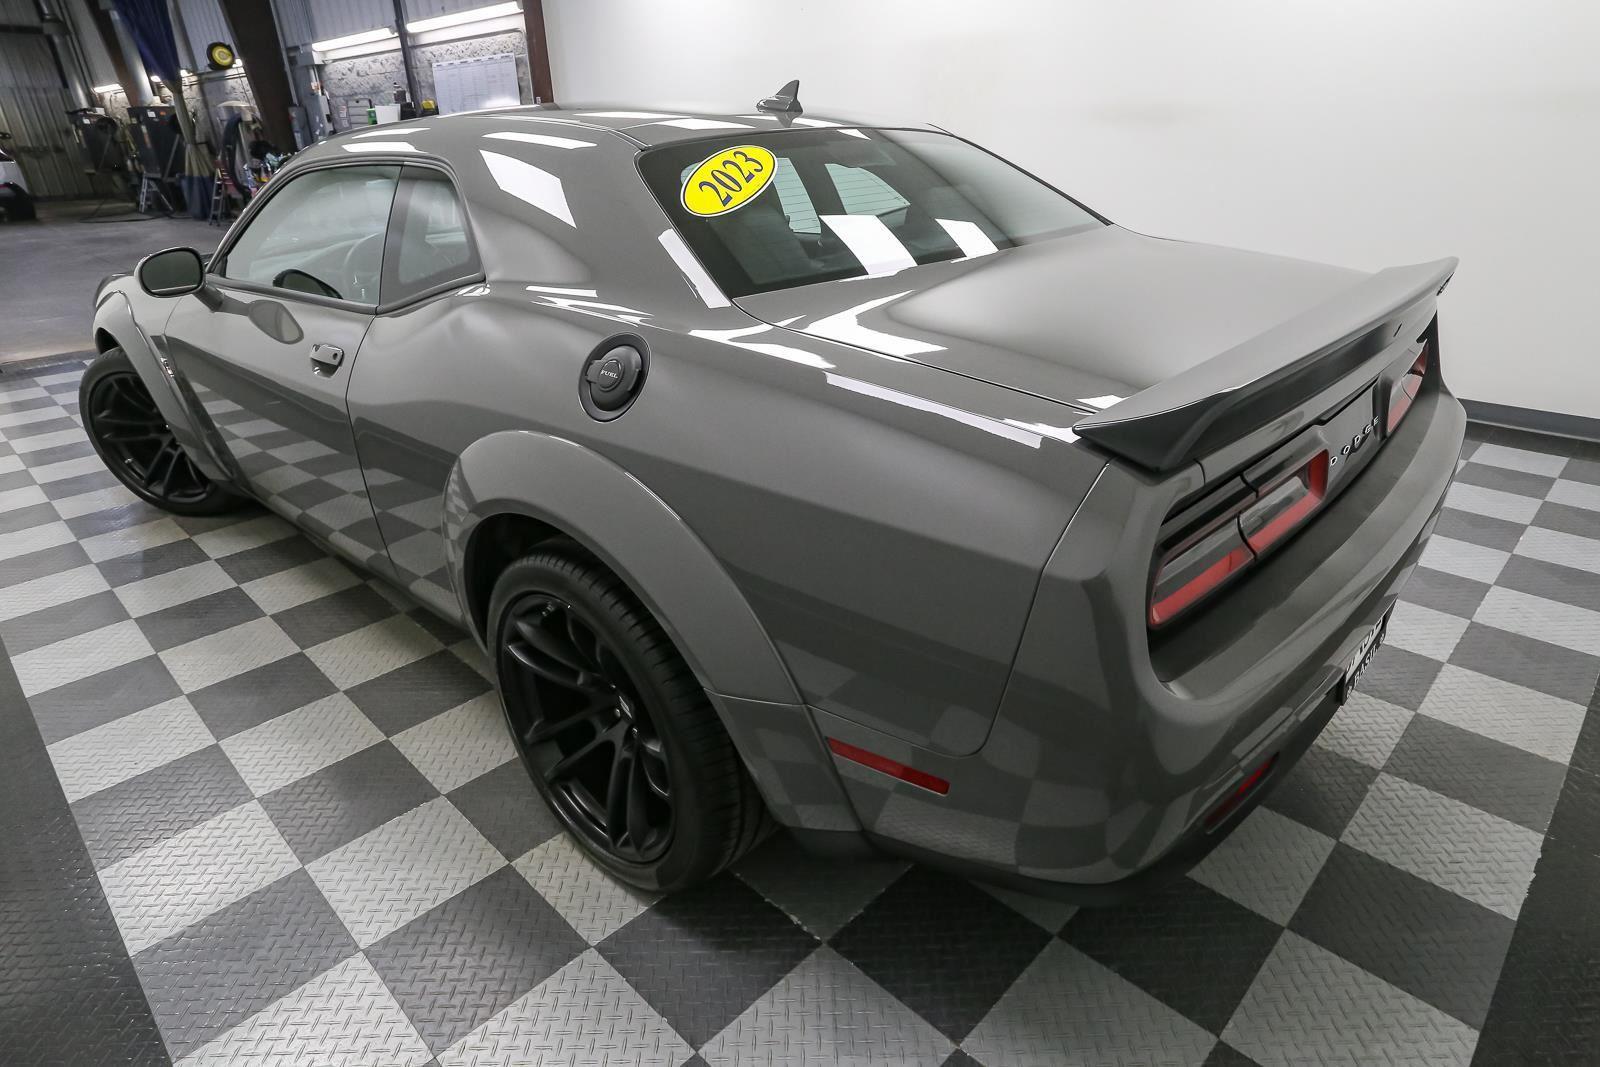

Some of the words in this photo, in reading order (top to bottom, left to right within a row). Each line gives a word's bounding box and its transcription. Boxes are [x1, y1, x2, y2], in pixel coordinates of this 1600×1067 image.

[698, 150, 764, 208] 2023
[600, 369, 619, 379] FUEL
[1329, 415, 1379, 467] DODGE
